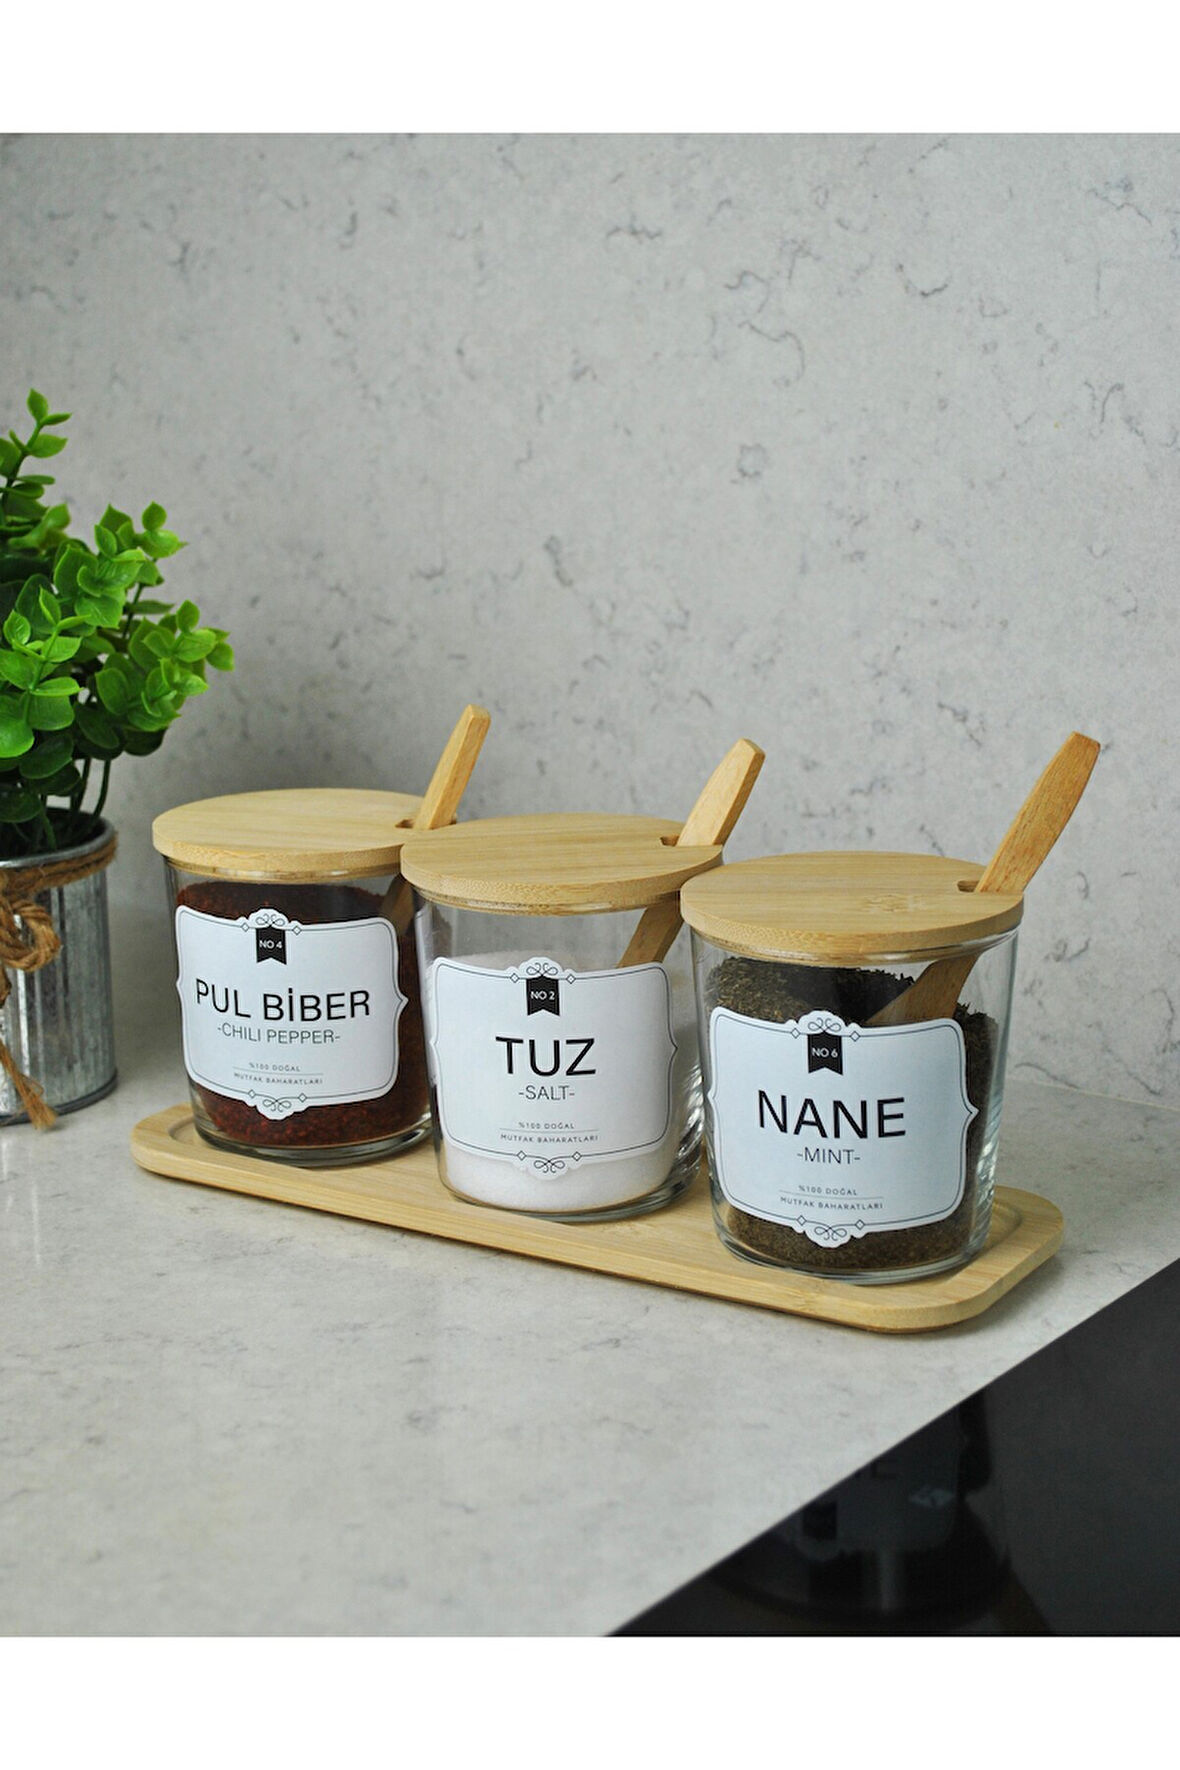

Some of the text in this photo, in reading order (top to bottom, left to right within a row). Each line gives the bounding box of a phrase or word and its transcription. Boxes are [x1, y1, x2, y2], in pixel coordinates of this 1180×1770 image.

[258, 940, 283, 949] NO 4
[195, 978, 370, 1022] PUL BİBER
[530, 991, 555, 1000] NO 2
[217, 1022, 341, 1045] -CHILI PEPPER-
[495, 1036, 596, 1076] TUZ
[811, 1047, 838, 1058] NO 6
[518, 1085, 575, 1101] -SALT-
[758, 1089, 906, 1139] NANE
[544, 1121, 575, 1130] DOĞAL
[500, 1133, 533, 1143] MUTFAK
[797, 1146, 861, 1165] -MINT-
[826, 1186, 858, 1196] DOĞAL
[780, 1196, 815, 1208] MUTFAK
